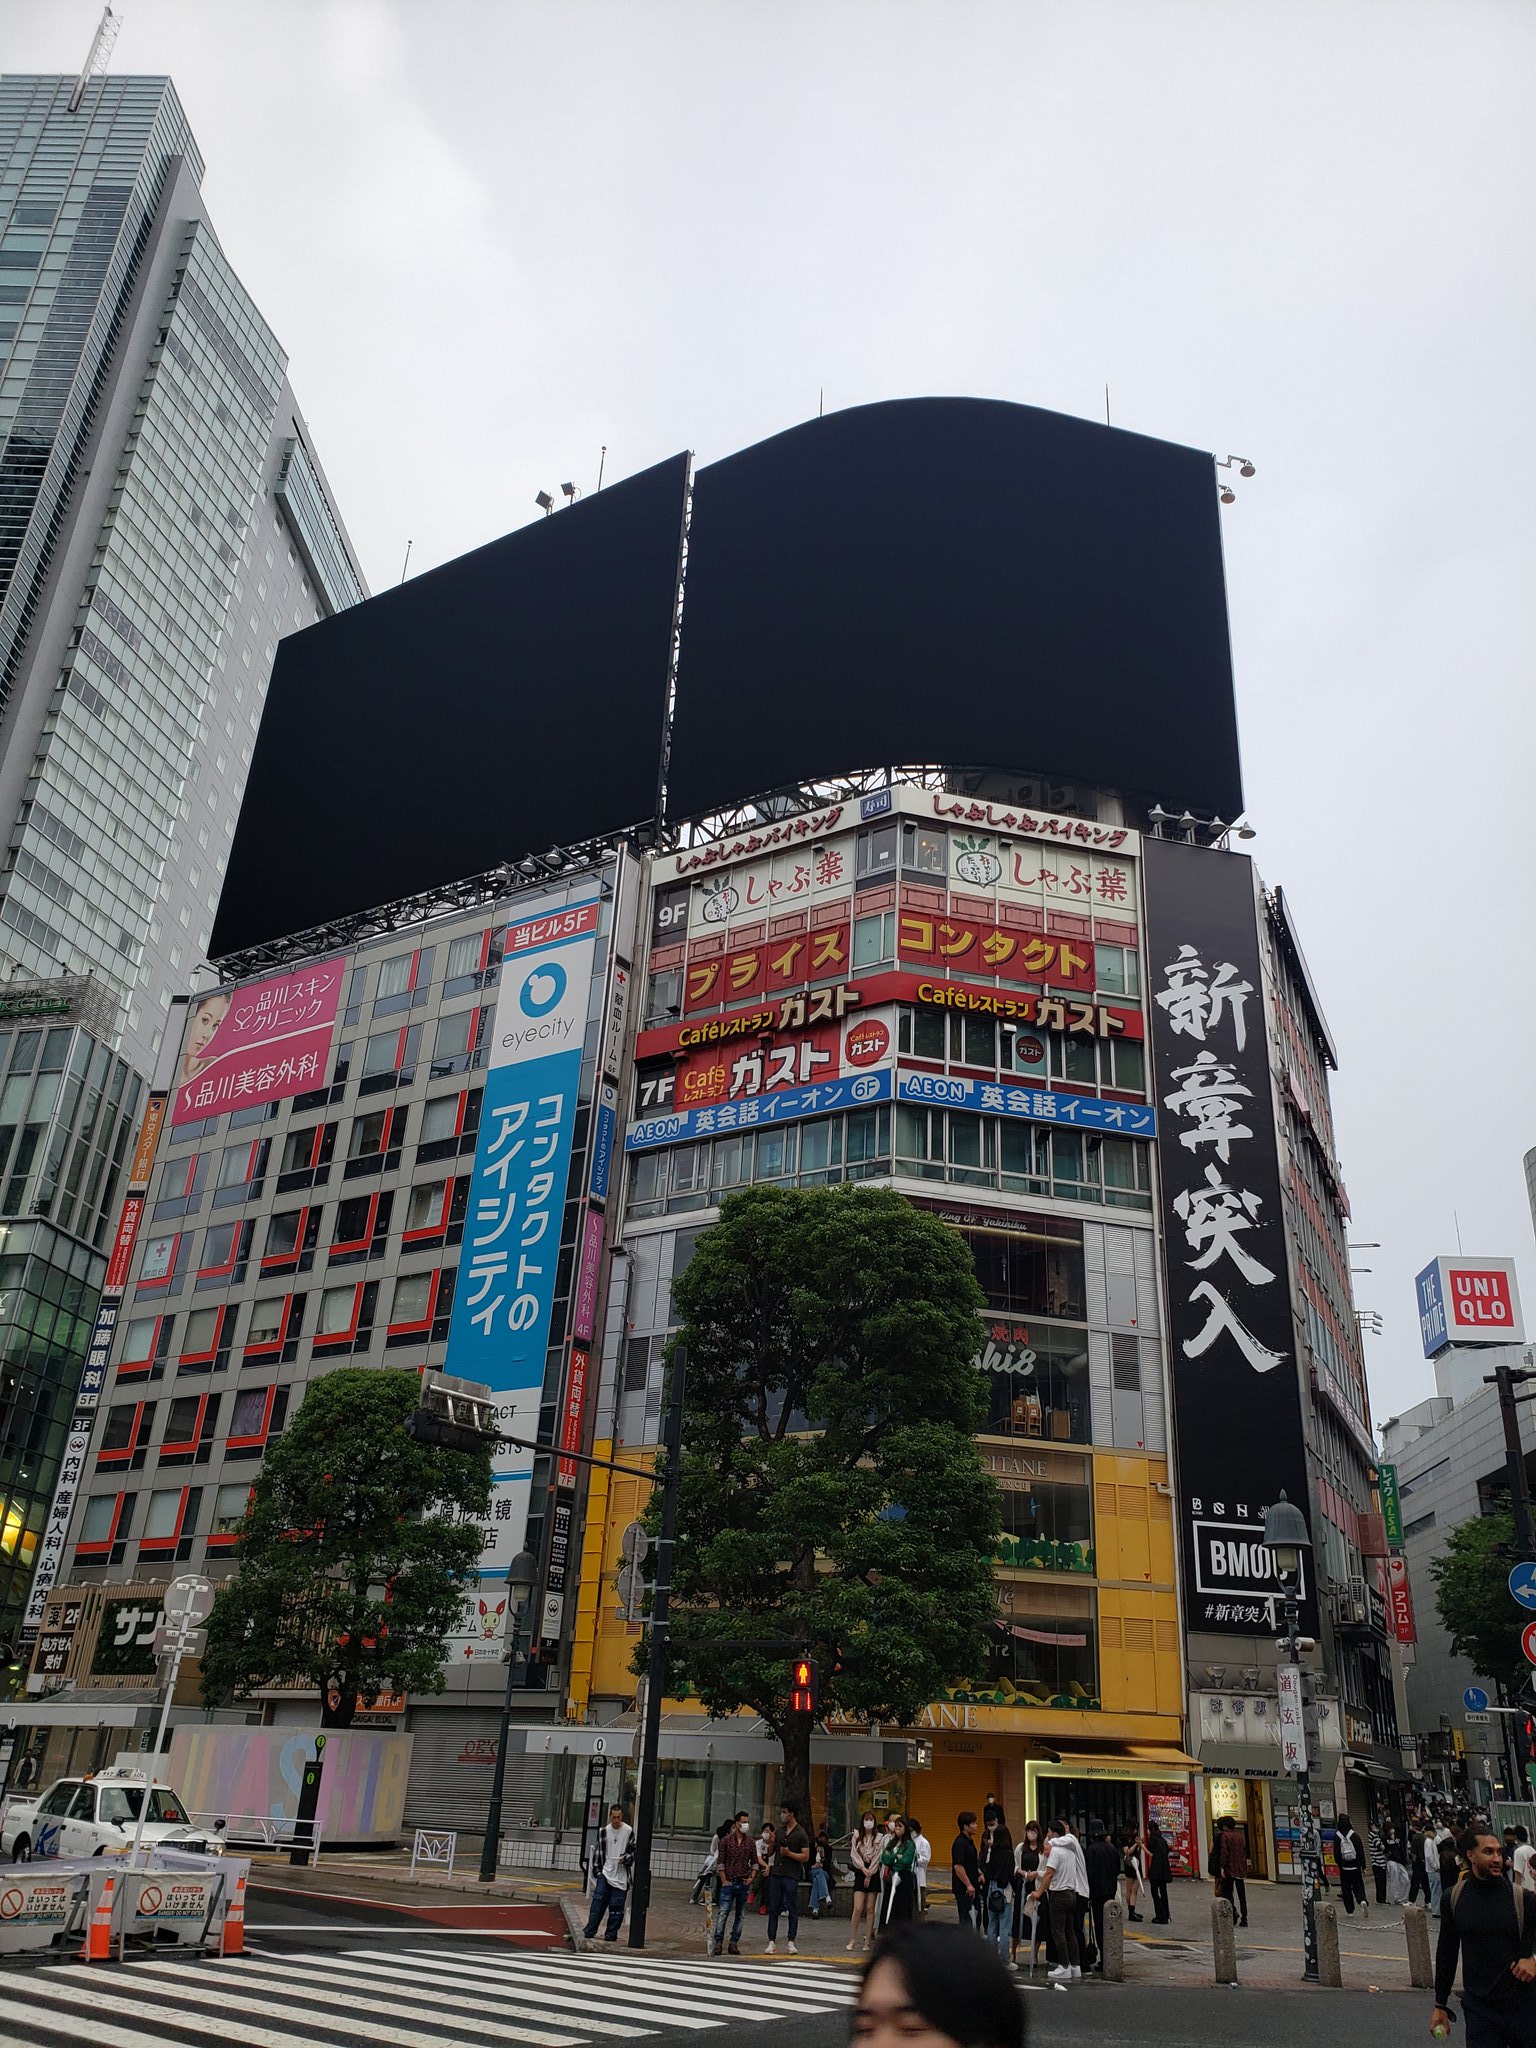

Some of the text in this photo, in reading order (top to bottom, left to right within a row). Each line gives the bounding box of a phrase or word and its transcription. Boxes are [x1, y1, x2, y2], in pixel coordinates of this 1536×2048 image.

[933, 794, 1129, 848] しゃぶしゃぶバイキング
[675, 806, 844, 874] しゃぶしゃぶバイキング
[746, 850, 844, 905] しゃぶ葉
[1013, 852, 1128, 902] しゃぶ葉
[513, 909, 590, 948] 当ビル5F
[658, 902, 688, 928] 9F
[688, 931, 847, 1000] プライス
[900, 917, 1089, 977] コンタクト
[255, 974, 336, 1012] 品川スキン
[778, 984, 860, 1031] ガスト
[251, 998, 323, 1035] クリニック
[502, 1017, 575, 1051] eyecity
[609, 993, 624, 1061] 献血ルーム
[1036, 998, 1124, 1037] ガスト
[851, 1039, 885, 1056] ガスト
[194, 1050, 320, 1109] 品川美容外科
[684, 1064, 727, 1091] Café
[730, 1042, 830, 1098] ガスト
[855, 1079, 878, 1098] 6F
[640, 1075, 676, 1107] 7F
[906, 1074, 1151, 1130] AEON 英会話イーオン
[633, 1085, 844, 1143] AEON 英会話イーオン
[1154, 944, 1292, 1374] 新章突入
[119, 1200, 139, 1247] 外貨両替
[508, 1093, 564, 1331] コンタクトの
[107, 1286, 121, 1294] 7F
[581, 1233, 599, 1319] 品川美容外科
[1421, 1273, 1437, 1310] THE
[1456, 1277, 1499, 1296] UNI
[577, 1322, 589, 1335] 4F
[1421, 1301, 1445, 1346] PRIME
[1460, 1299, 1506, 1322] QLO
[84, 1308, 116, 1389] 加藤眼科
[79, 1395, 97, 1405] 5F
[569, 1352, 586, 1418] 外貨両替
[73, 1421, 91, 1432] 3F
[561, 1475, 573, 1485] 7F
[47, 1606, 62, 1627] 薬
[1395, 1591, 1409, 1624] アコム
[40, 1636, 72, 1652] 処方せん
[43, 1654, 63, 1670] 受付
[1280, 1674, 1298, 1760] 道玄坂
[1244, 1768, 1279, 1778] EKIMAE
[25, 1903, 65, 1912] いけません
[27, 1895, 67, 1904] はいっては
[164, 1901, 204, 1909] いけません
[166, 1893, 205, 1901] はいっては
